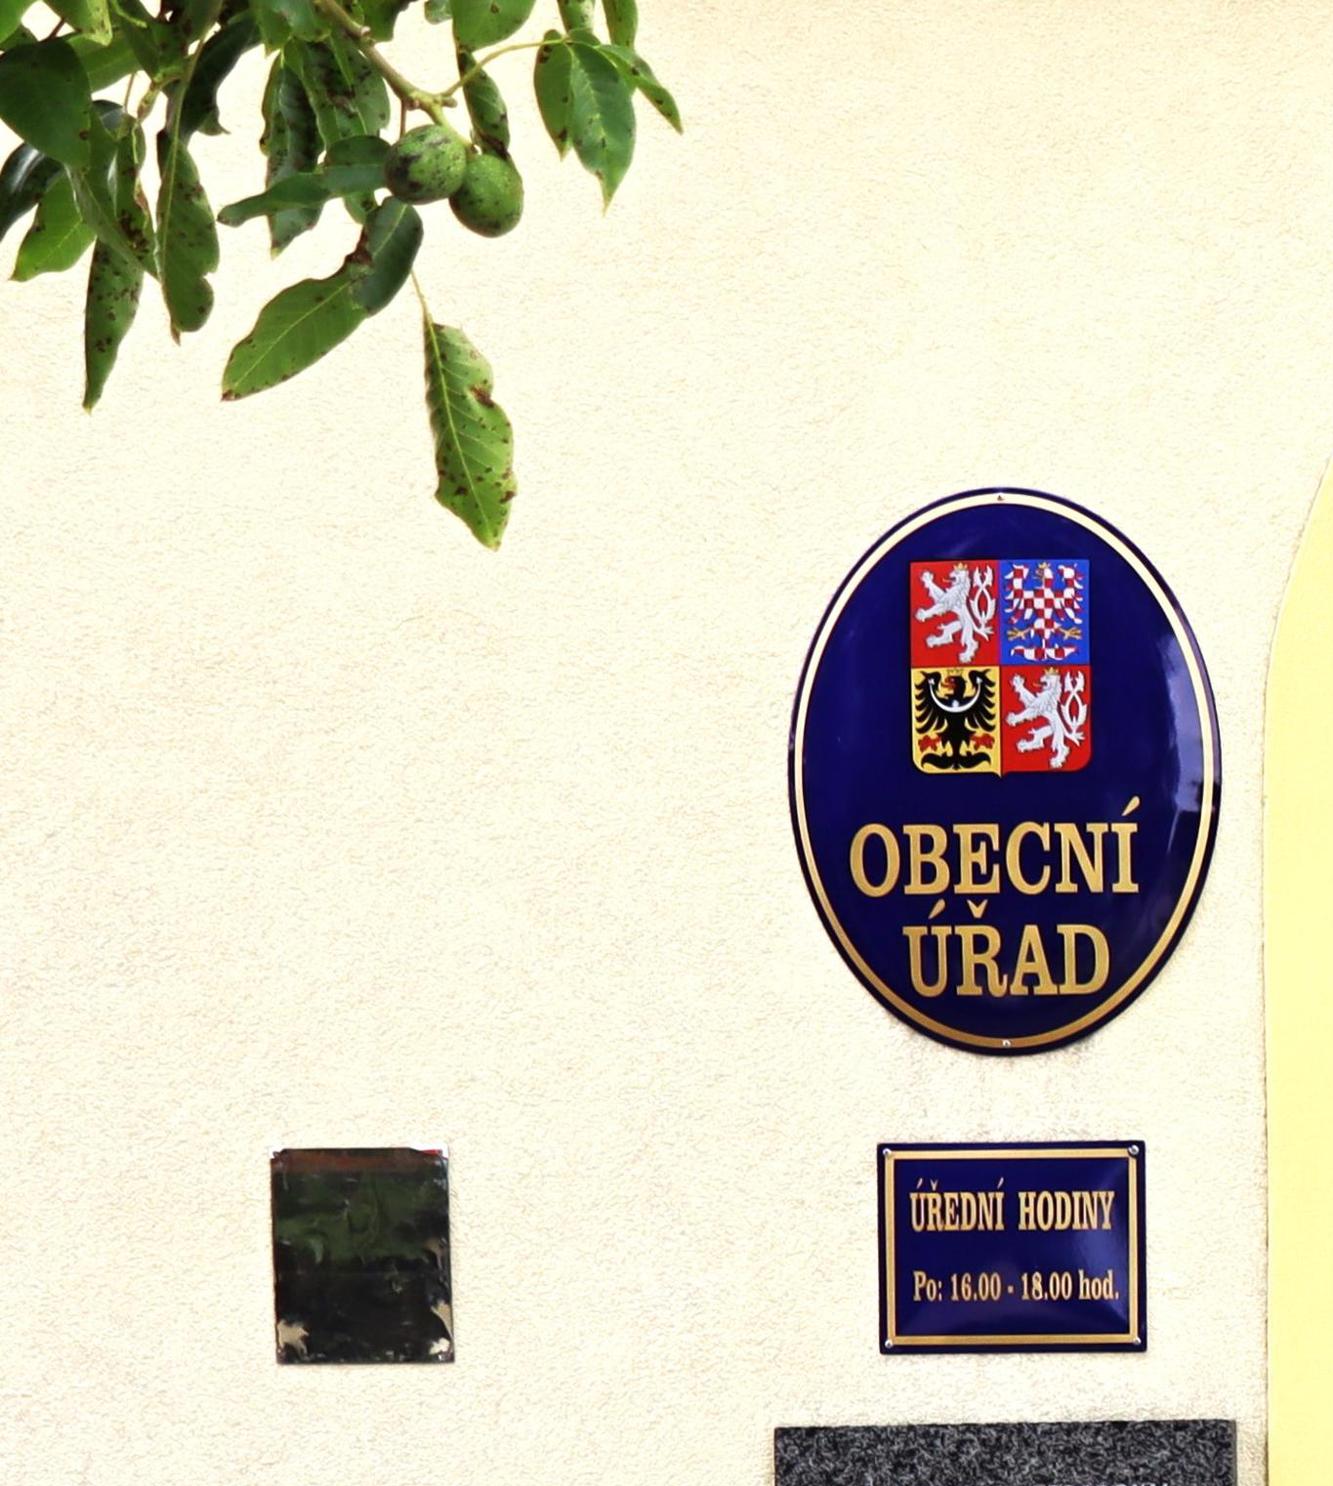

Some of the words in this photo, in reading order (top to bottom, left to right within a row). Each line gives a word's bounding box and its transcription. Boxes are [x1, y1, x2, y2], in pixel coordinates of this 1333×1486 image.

[849, 796, 1141, 898] OBECNÍ
[902, 898, 1111, 998] ÚŘAD
[909, 1177, 1005, 1232] ÚŘEDNÍ
[1017, 1190, 1116, 1232] HODINY
[912, 1270, 943, 1302] Po:
[950, 1272, 1002, 1301] 16.00
[1021, 1271, 1073, 1301] 18.00
[1078, 1269, 1120, 1300] hod.
